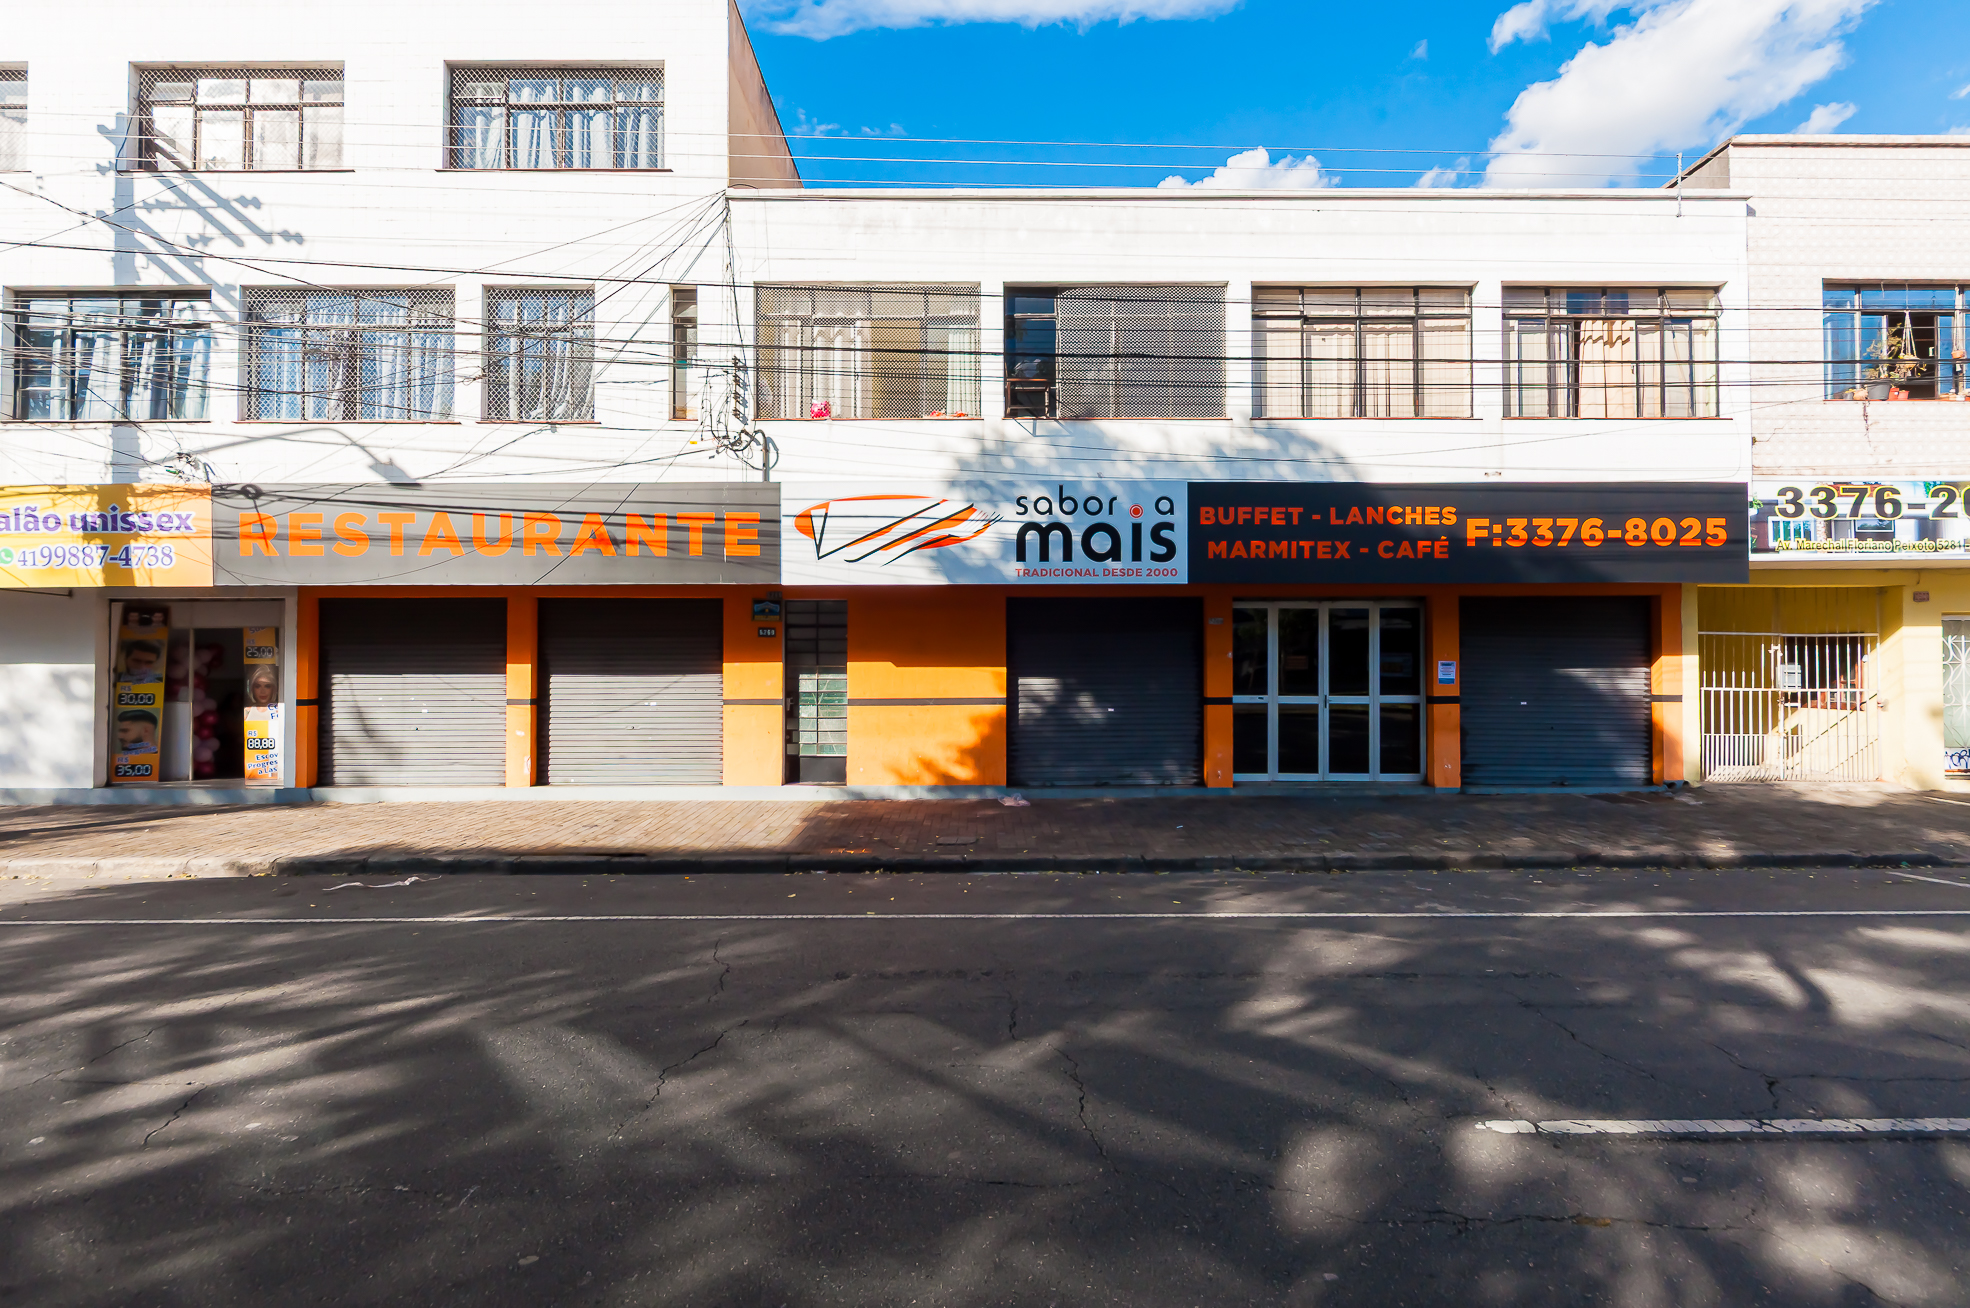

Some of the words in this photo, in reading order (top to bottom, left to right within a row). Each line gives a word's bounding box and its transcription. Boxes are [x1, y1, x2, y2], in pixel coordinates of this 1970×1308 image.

[1016, 484, 1117, 516] sabor
[1154, 496, 1175, 516] a
[1775, 485, 1970, 520] 3376-2
[69, 504, 194, 532] unissex
[1200, 506, 1304, 525] BUFFET
[1330, 506, 1458, 525] LANCHES
[238, 511, 762, 557] RESTAURANTE
[1016, 504, 1177, 563] mais
[1466, 517, 1728, 547] F:3376-8025
[1208, 541, 1351, 559] MARMITEX
[1377, 536, 1449, 559] CAFÉ
[1776, 539, 1793, 551] Av.
[1796, 538, 1846, 551] Marechal
[1848, 538, 1892, 551] Floriano
[1894, 539, 1935, 551] Peixoto
[1937, 539, 1962, 550] 5281
[1015, 568, 1099, 577] TRADICIONAL
[1103, 568, 1142, 577] DESDE
[1146, 568, 1178, 577] 2000
[120, 693, 155, 705] 30,00
[247, 738, 275, 750] 88,88
[117, 764, 151, 776] 35,00
